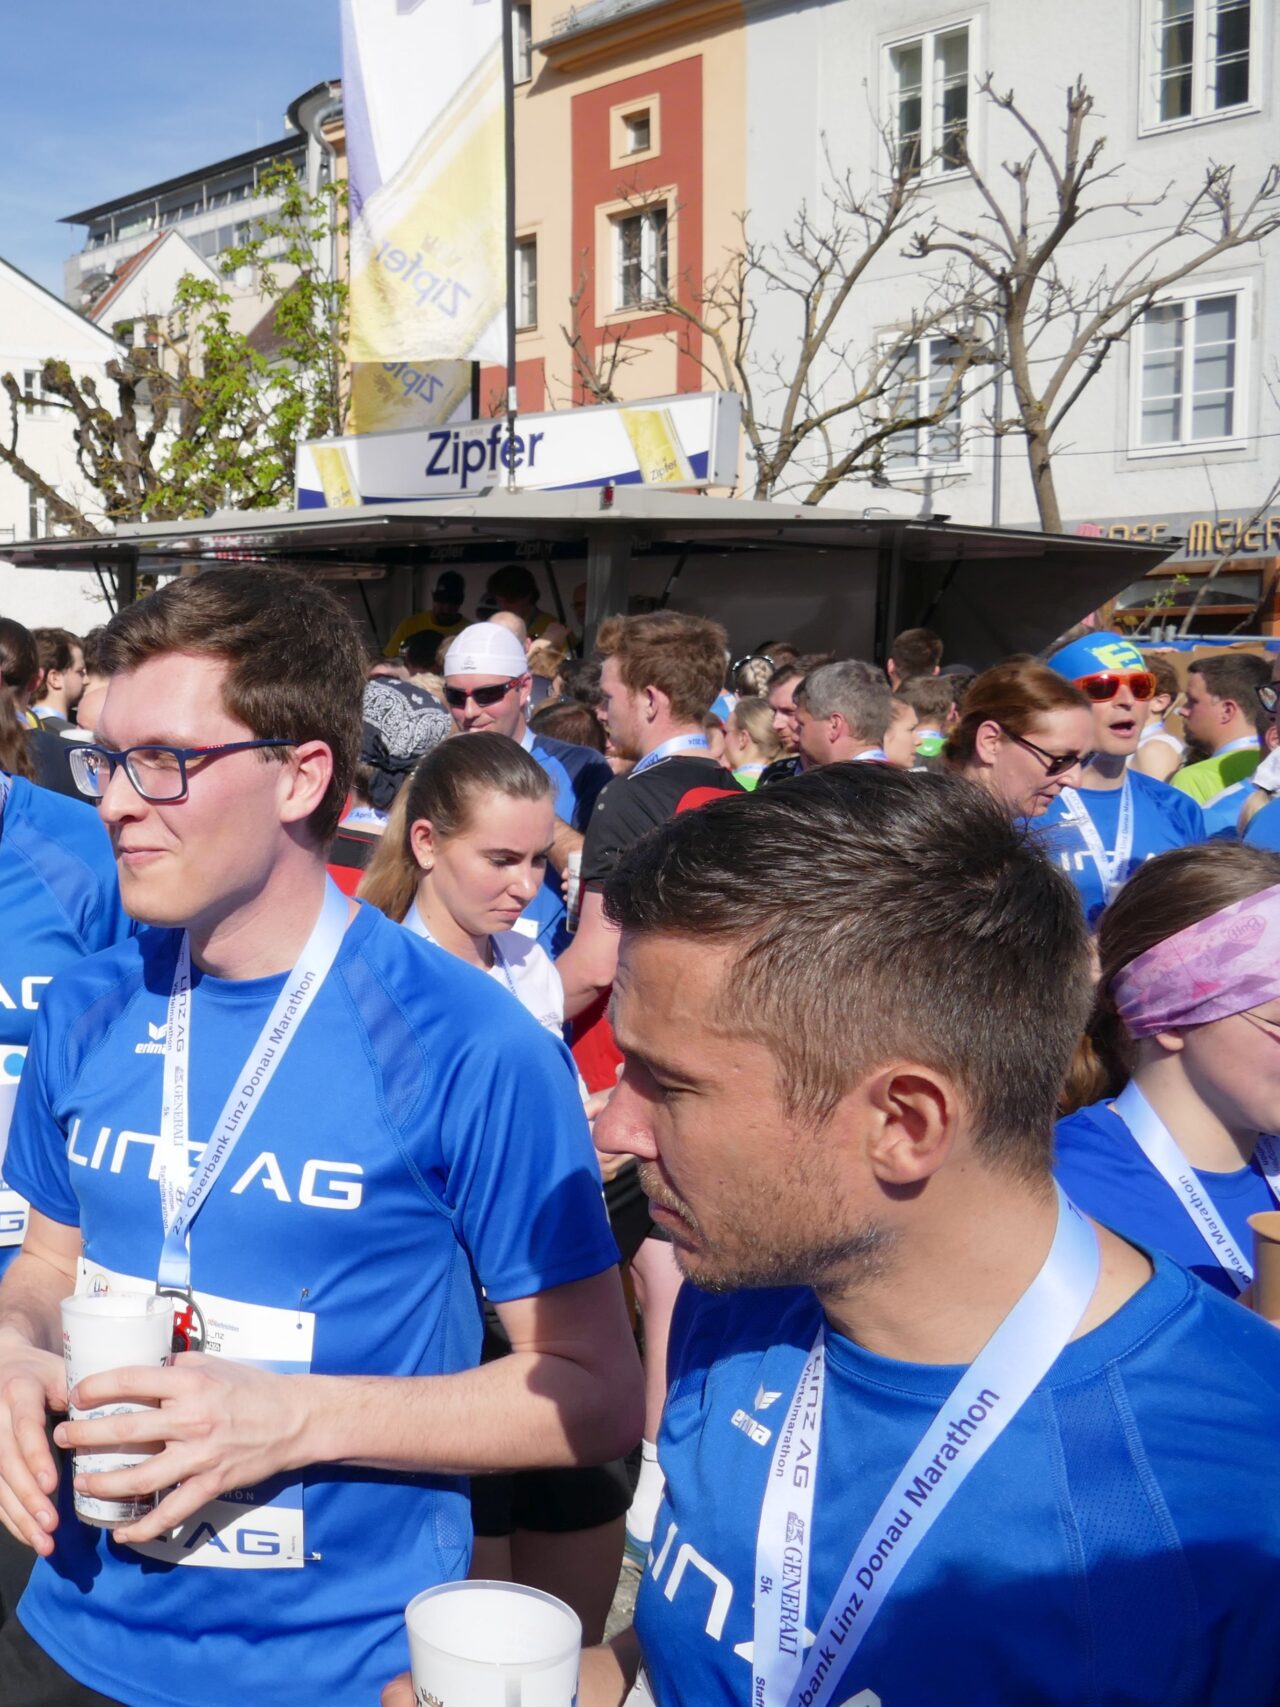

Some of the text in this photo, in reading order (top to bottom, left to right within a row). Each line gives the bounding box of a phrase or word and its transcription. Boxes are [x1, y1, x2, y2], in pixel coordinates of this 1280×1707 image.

[425, 423, 544, 488] Zipfer
[649, 461, 677, 481] Zipfer
[515, 540, 554, 559] Zipfr
[175, 1025, 186, 1053] AG
[172, 970, 316, 1236] 22. Oberbank Linz Donau Marathon
[173, 1084, 184, 1146] GENERALI
[230, 1152, 363, 1210] AG
[1178, 1174, 1252, 1285] onau Marathon
[775, 1361, 813, 1478] Viertelmarathon
[792, 1438, 812, 1489] AG
[183, 1520, 281, 1556] AG
[831, 1592, 864, 1646] Linz
[855, 1507, 913, 1591] Donau
[904, 1386, 1001, 1509] Marathon
[759, 1574, 773, 1595] 5k
[779, 1546, 803, 1657] GENERALI
